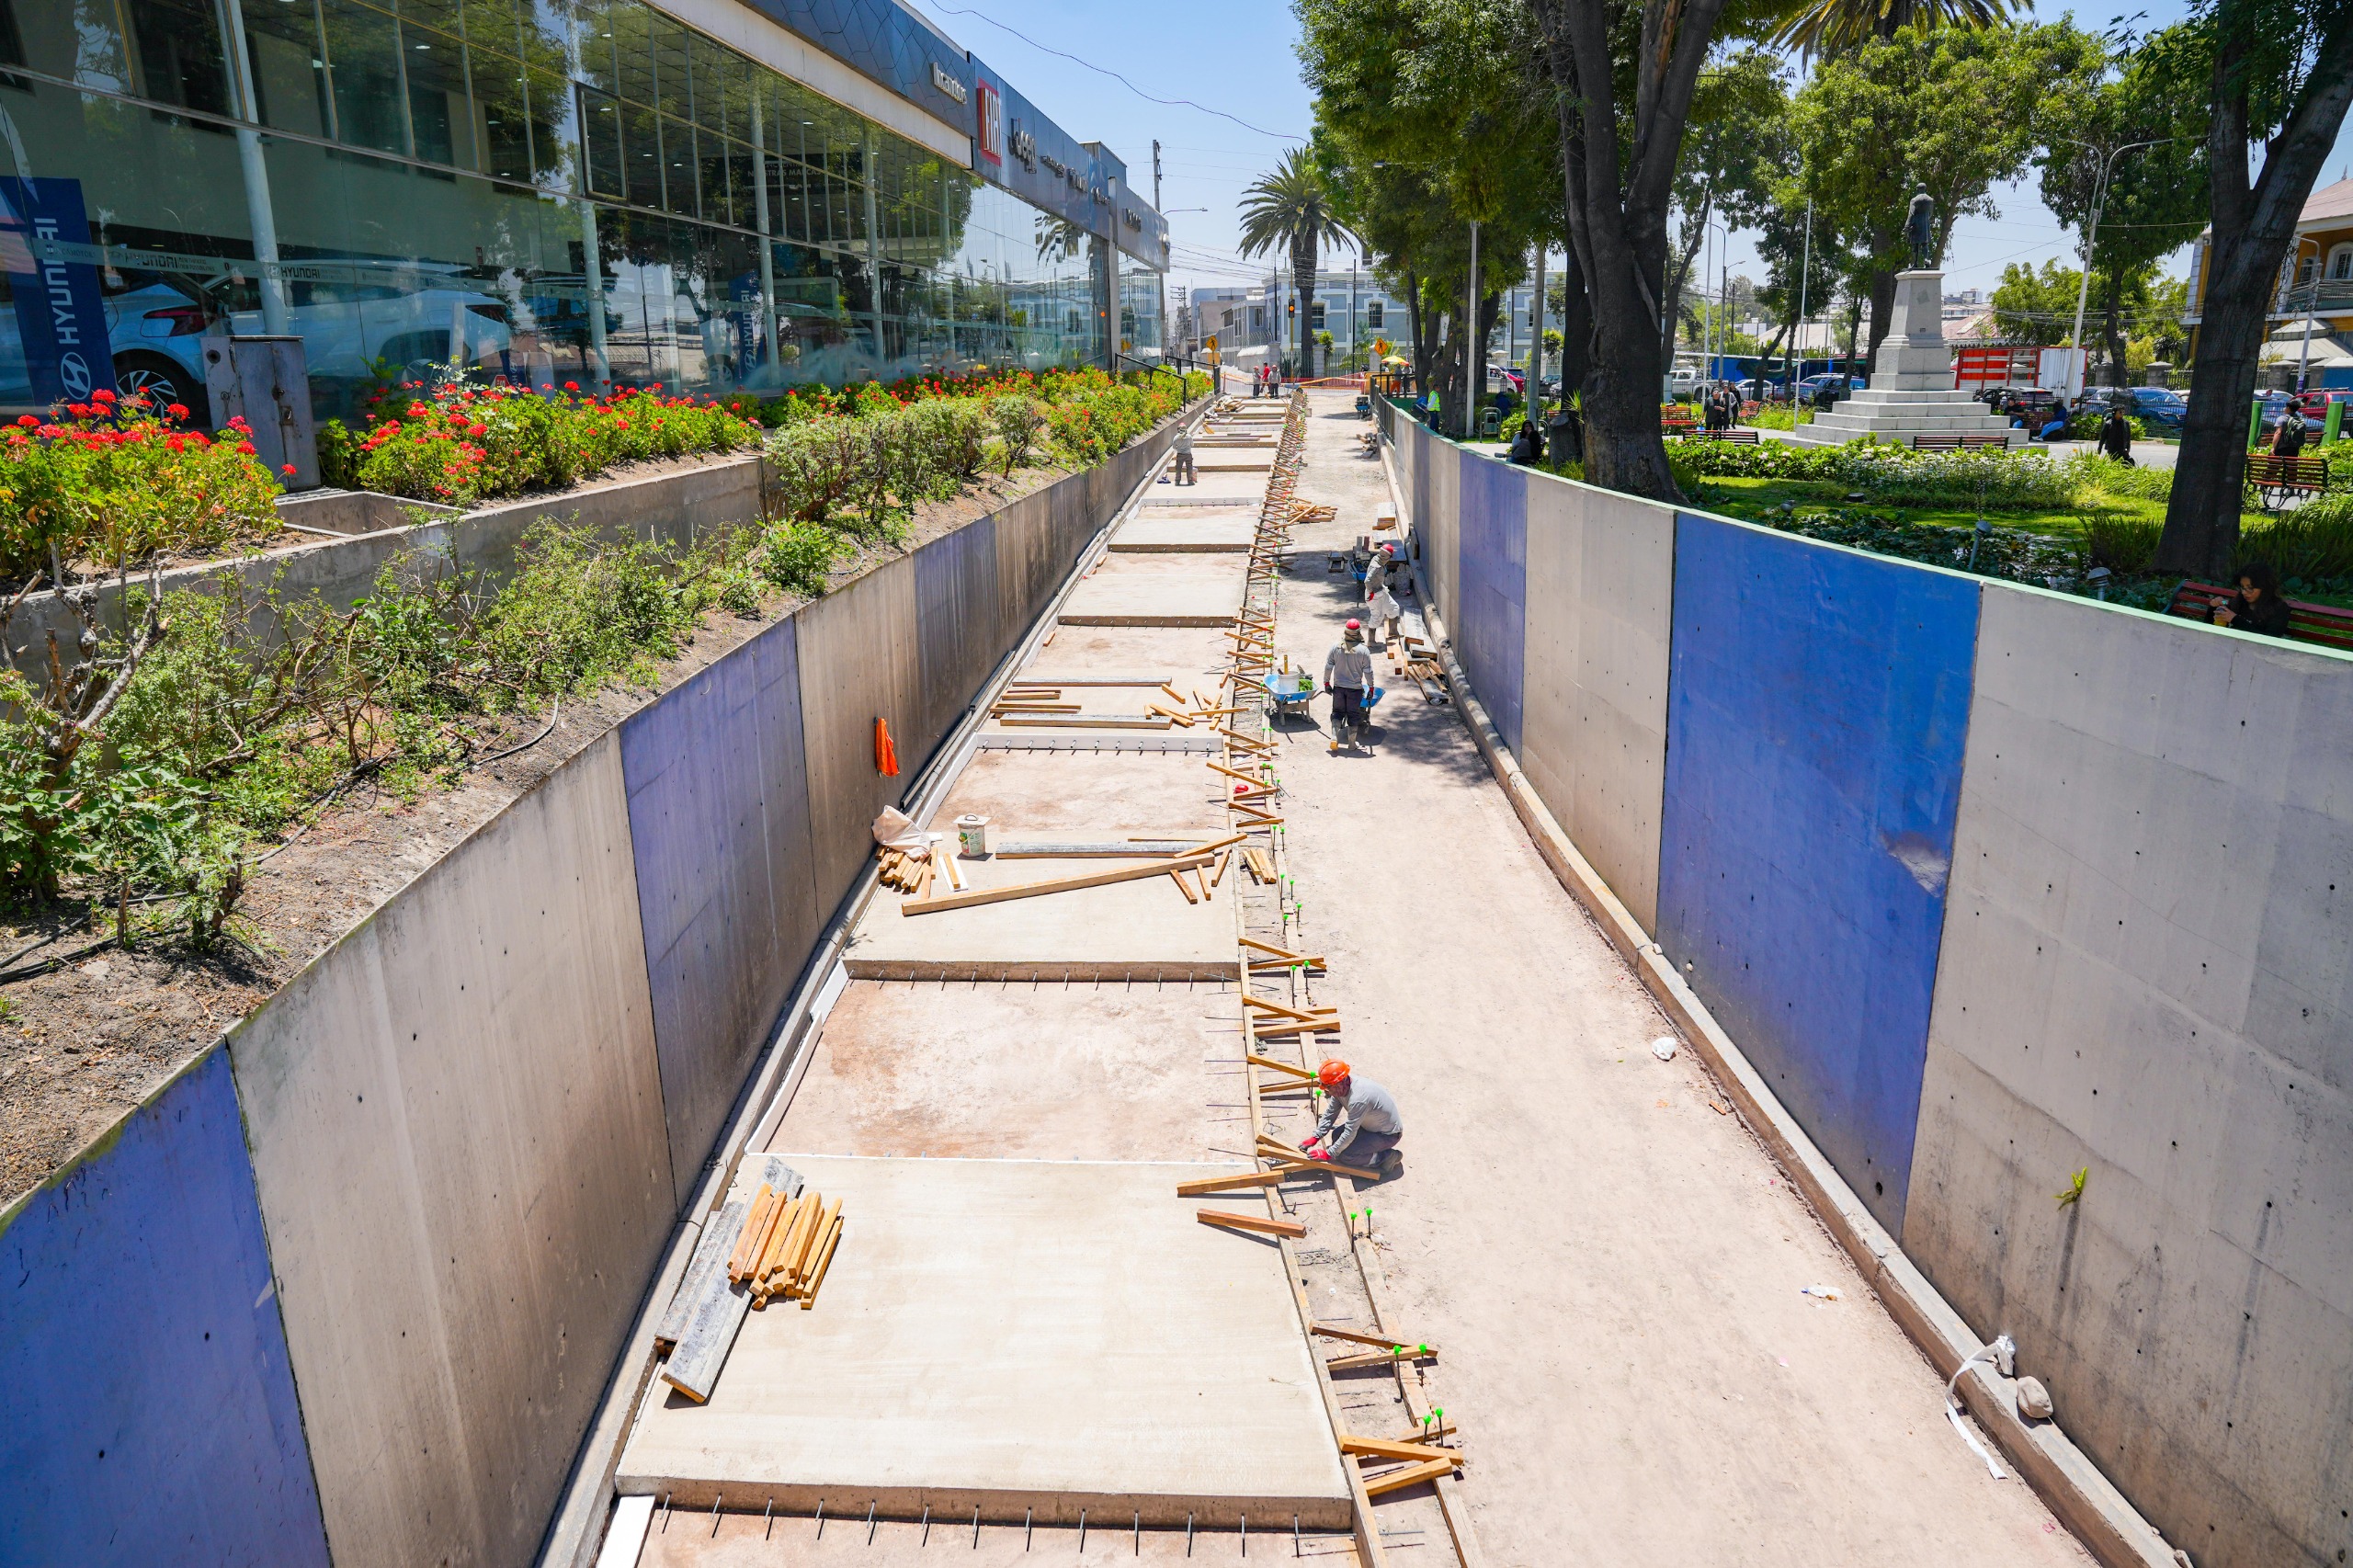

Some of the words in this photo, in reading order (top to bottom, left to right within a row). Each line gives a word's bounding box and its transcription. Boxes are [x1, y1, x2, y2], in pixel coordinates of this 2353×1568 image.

[984, 87, 1003, 157] FIAT
[789, 168, 822, 176] MACAS
[124, 253, 179, 269] HUNDAI
[280, 267, 321, 279] HYUNDAI
[740, 290, 754, 347] HYUNAI
